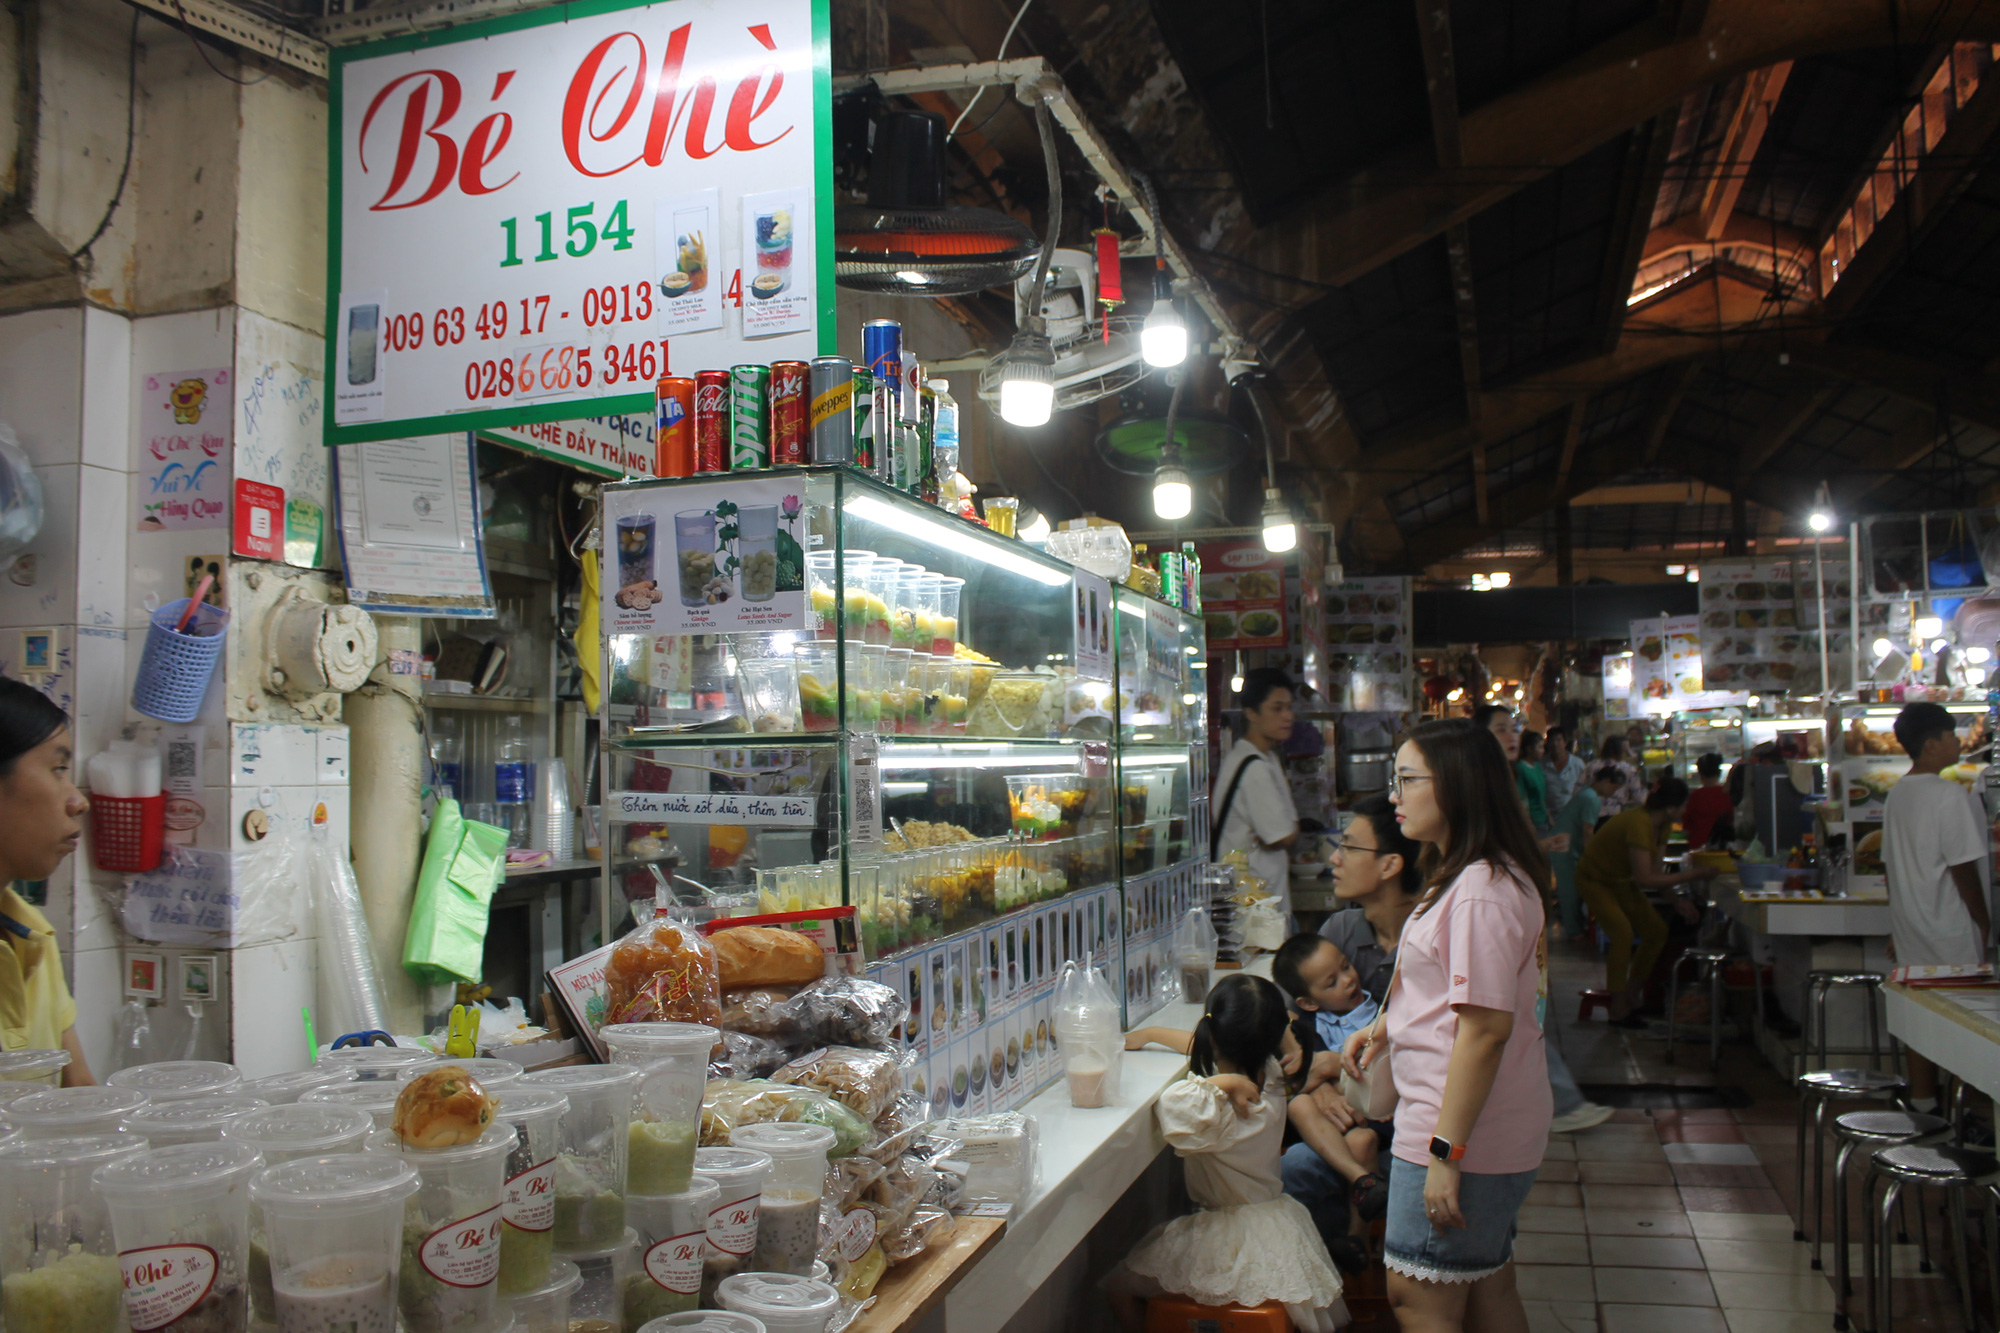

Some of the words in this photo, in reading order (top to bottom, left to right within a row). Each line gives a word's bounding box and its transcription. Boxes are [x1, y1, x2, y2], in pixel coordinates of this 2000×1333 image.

[359, 69, 520, 211] Bé
[561, 21, 795, 178] Chè
[500, 198, 635, 268] 1154
[433, 306, 465, 347] 63
[475, 301, 507, 340] 49
[520, 294, 550, 335] 17
[583, 280, 653, 328] 0913
[603, 338, 673, 385] 3461
[620, 796, 658, 813] Thêm
[748, 800, 777, 817] thêm
[526, 1176, 549, 1196] Bé
[729, 1209, 750, 1225] Bé
[455, 1227, 486, 1250] Bé
[673, 1243, 696, 1260] Bé
[134, 1258, 177, 1287] Chè
